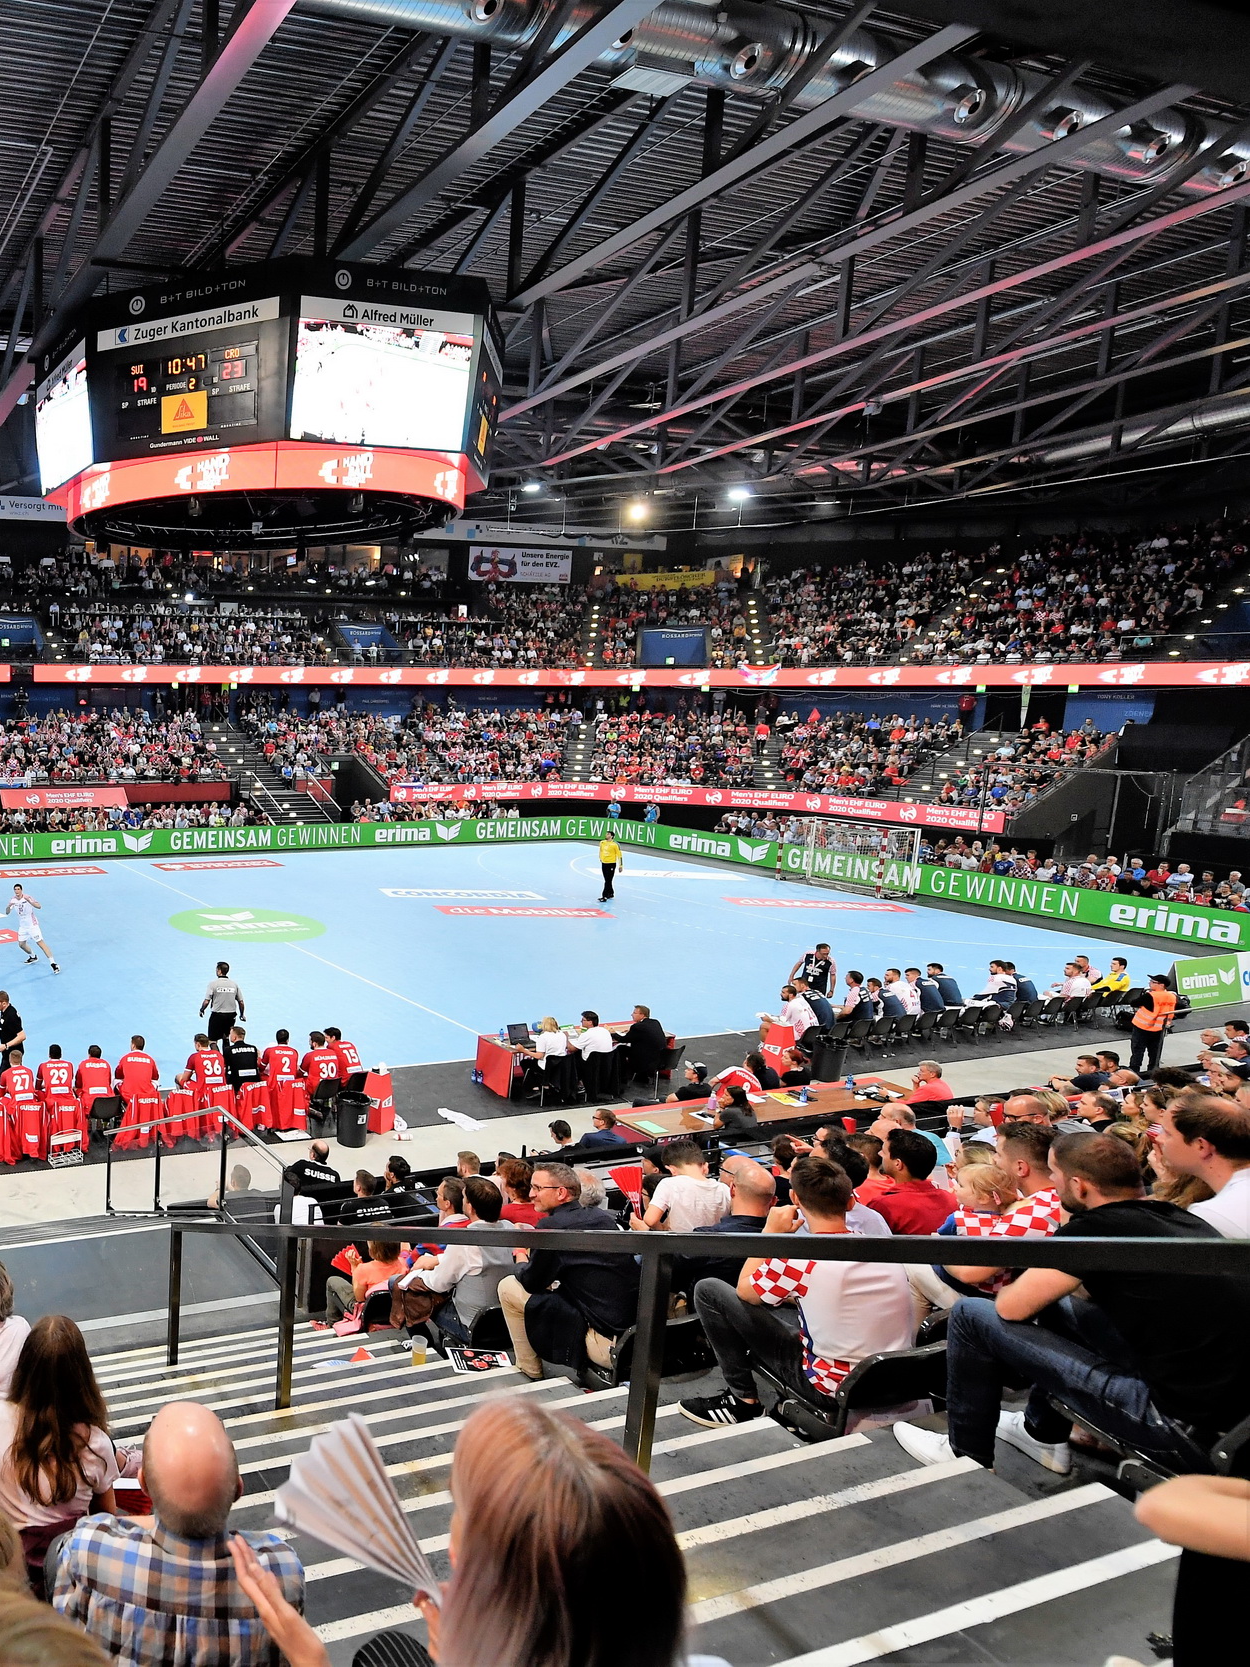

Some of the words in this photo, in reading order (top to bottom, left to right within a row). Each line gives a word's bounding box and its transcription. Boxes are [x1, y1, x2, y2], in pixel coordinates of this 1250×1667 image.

[186, 279, 246, 299] BILD+TON
[392, 281, 447, 296] BILD+TON
[134, 324, 168, 341] Zuger
[171, 305, 260, 334] Kantonalbank
[361, 309, 397, 323] Alfred
[400, 313, 434, 327] Müller
[224, 347, 240, 359] CRO
[131, 364, 144, 375] SUI
[168, 354, 205, 375] 10:47
[222, 360, 242, 380] 23
[133, 377, 147, 392] 19
[166, 382, 187, 391] PERIODE
[189, 378, 196, 390] 2
[228, 383, 251, 393] STRAFE
[137, 397, 157, 407] STRAFE
[149, 440, 183, 449] Gundermann
[9, 500, 46, 512] Versorgt
[521, 551, 544, 560] Unsere
[546, 552, 570, 561] Energie
[634, 786, 655, 794] Men's
[654, 794, 688, 802] Qualifiers
[731, 797, 752, 805] 2020
[752, 798, 789, 807] Qualifiers
[828, 797, 849, 806] Men's
[867, 801, 887, 809] EURO
[848, 806, 882, 817] Qualifiers
[926, 807, 950, 816] Men's
[925, 815, 948, 823] 2020
[170, 829, 271, 850] GEMEINSAM
[277, 826, 361, 846] GEWINNEN
[375, 825, 431, 843] erima
[476, 819, 561, 839] GEMEINSAM
[566, 819, 656, 845] GEWINNEN
[669, 833, 731, 857] erima
[50, 834, 117, 855] erima
[390, 889, 537, 899] CONCORDIA
[449, 906, 481, 915] die
[483, 906, 598, 917] Mobiliar
[931, 870, 1080, 917] GEWINNEN
[1108, 902, 1241, 944] erima
[200, 920, 301, 932] erima
[1182, 972, 1219, 990] erima
[231, 1046, 256, 1055] SUISSE
[342, 1049, 359, 1064] 15
[127, 1056, 151, 1064] SUISSE
[281, 1056, 291, 1073] 2
[202, 1059, 221, 1075] 36
[319, 1062, 337, 1079] 30
[13, 1074, 30, 1091] 27
[50, 1068, 68, 1085] 29
[304, 1168, 337, 1184] SUISSE
